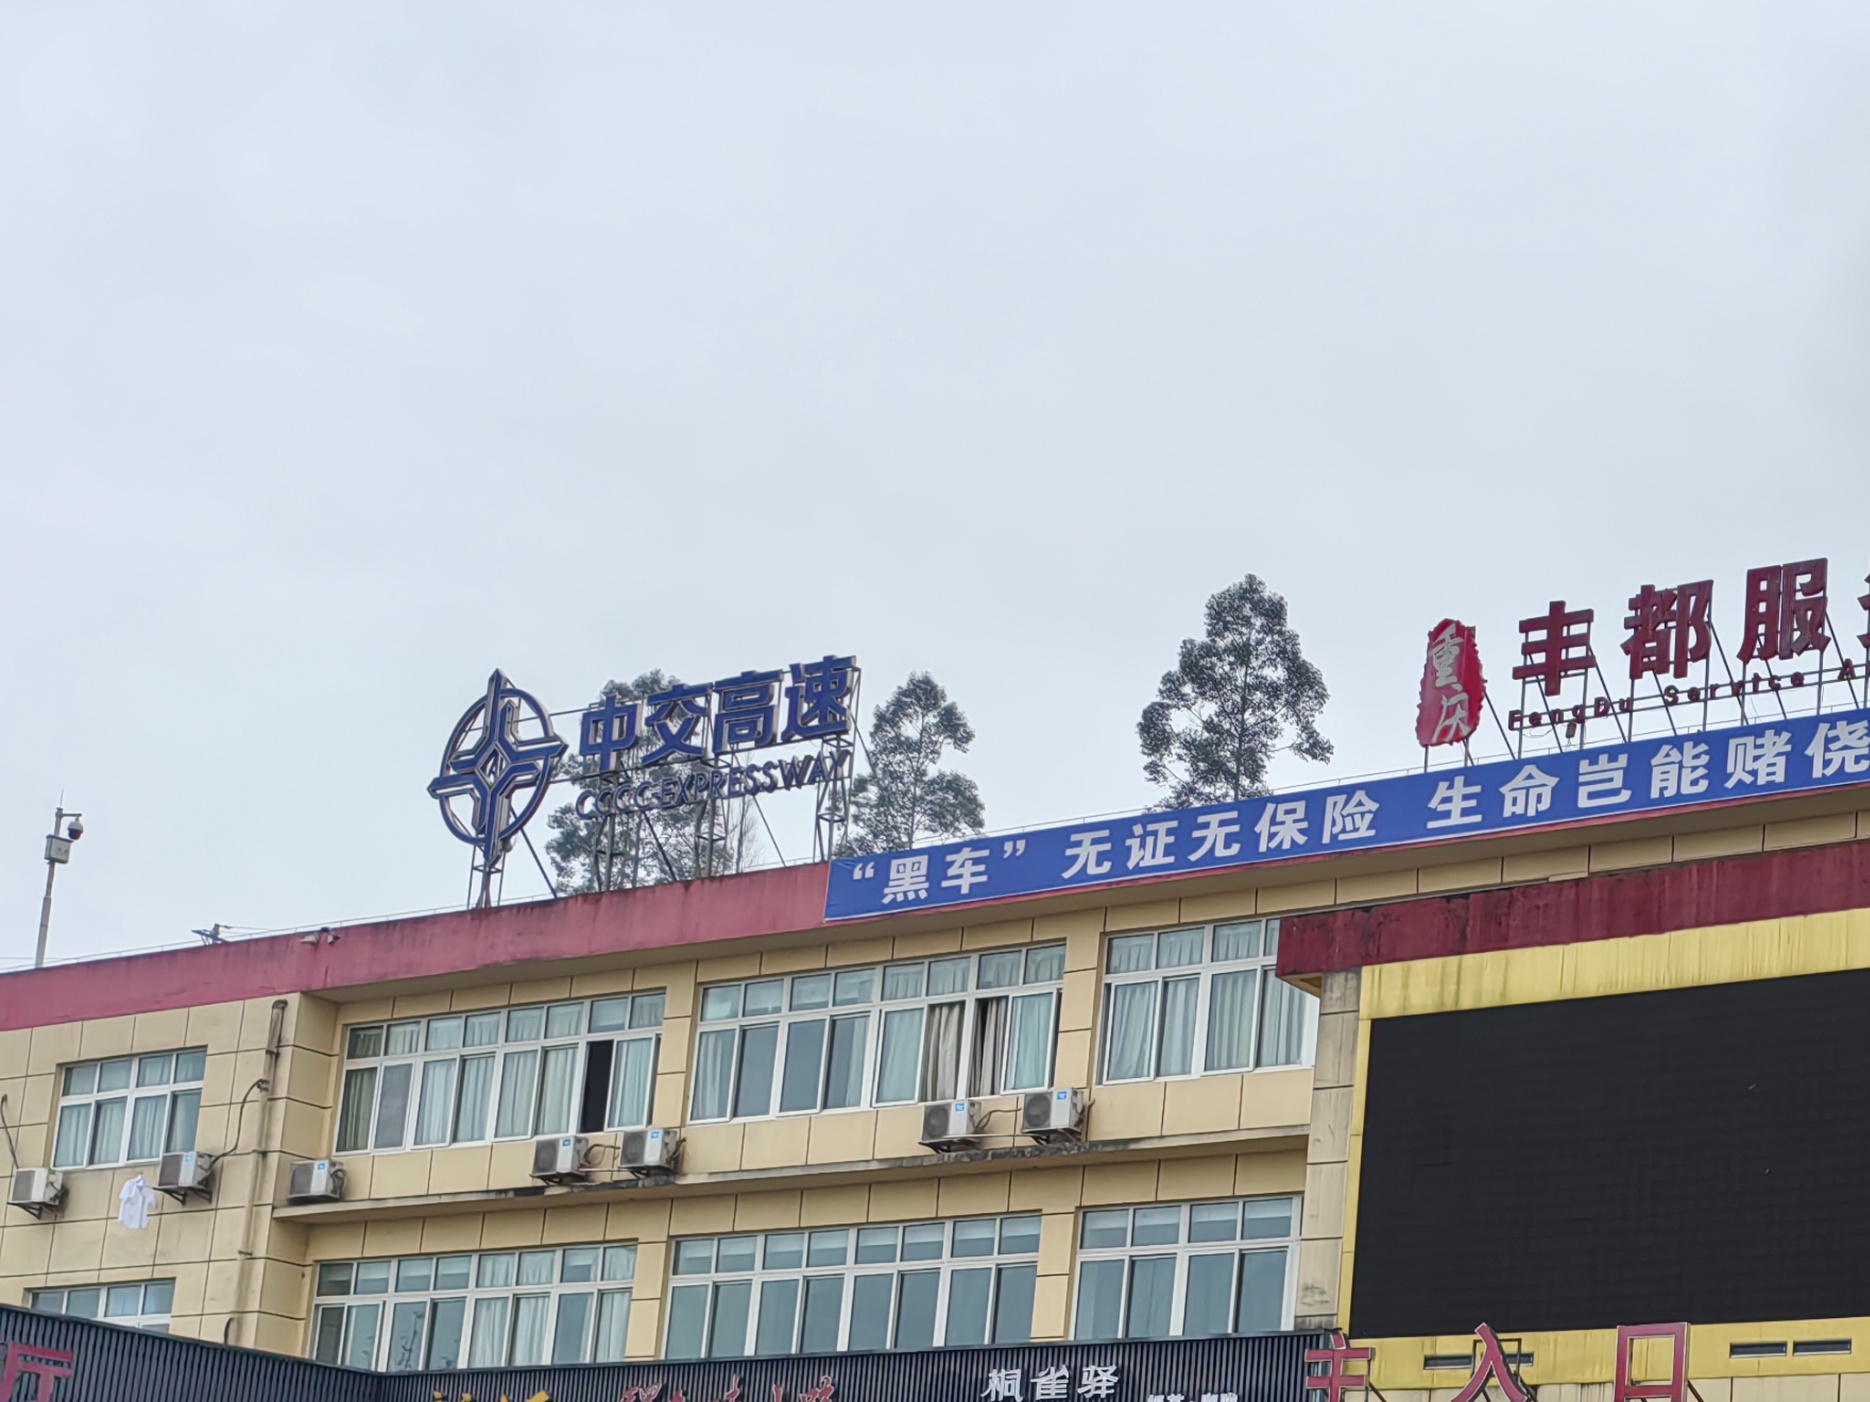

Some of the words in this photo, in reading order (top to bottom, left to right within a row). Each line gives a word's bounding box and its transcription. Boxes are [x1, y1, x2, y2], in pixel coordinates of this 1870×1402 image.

[580, 655, 858, 773] 中交高速
[1423, 619, 1474, 745] 重庆
[576, 781, 656, 821] CCCC
[659, 750, 854, 812] EXPRESSWAY
[1061, 790, 1380, 880] 无证无保险
